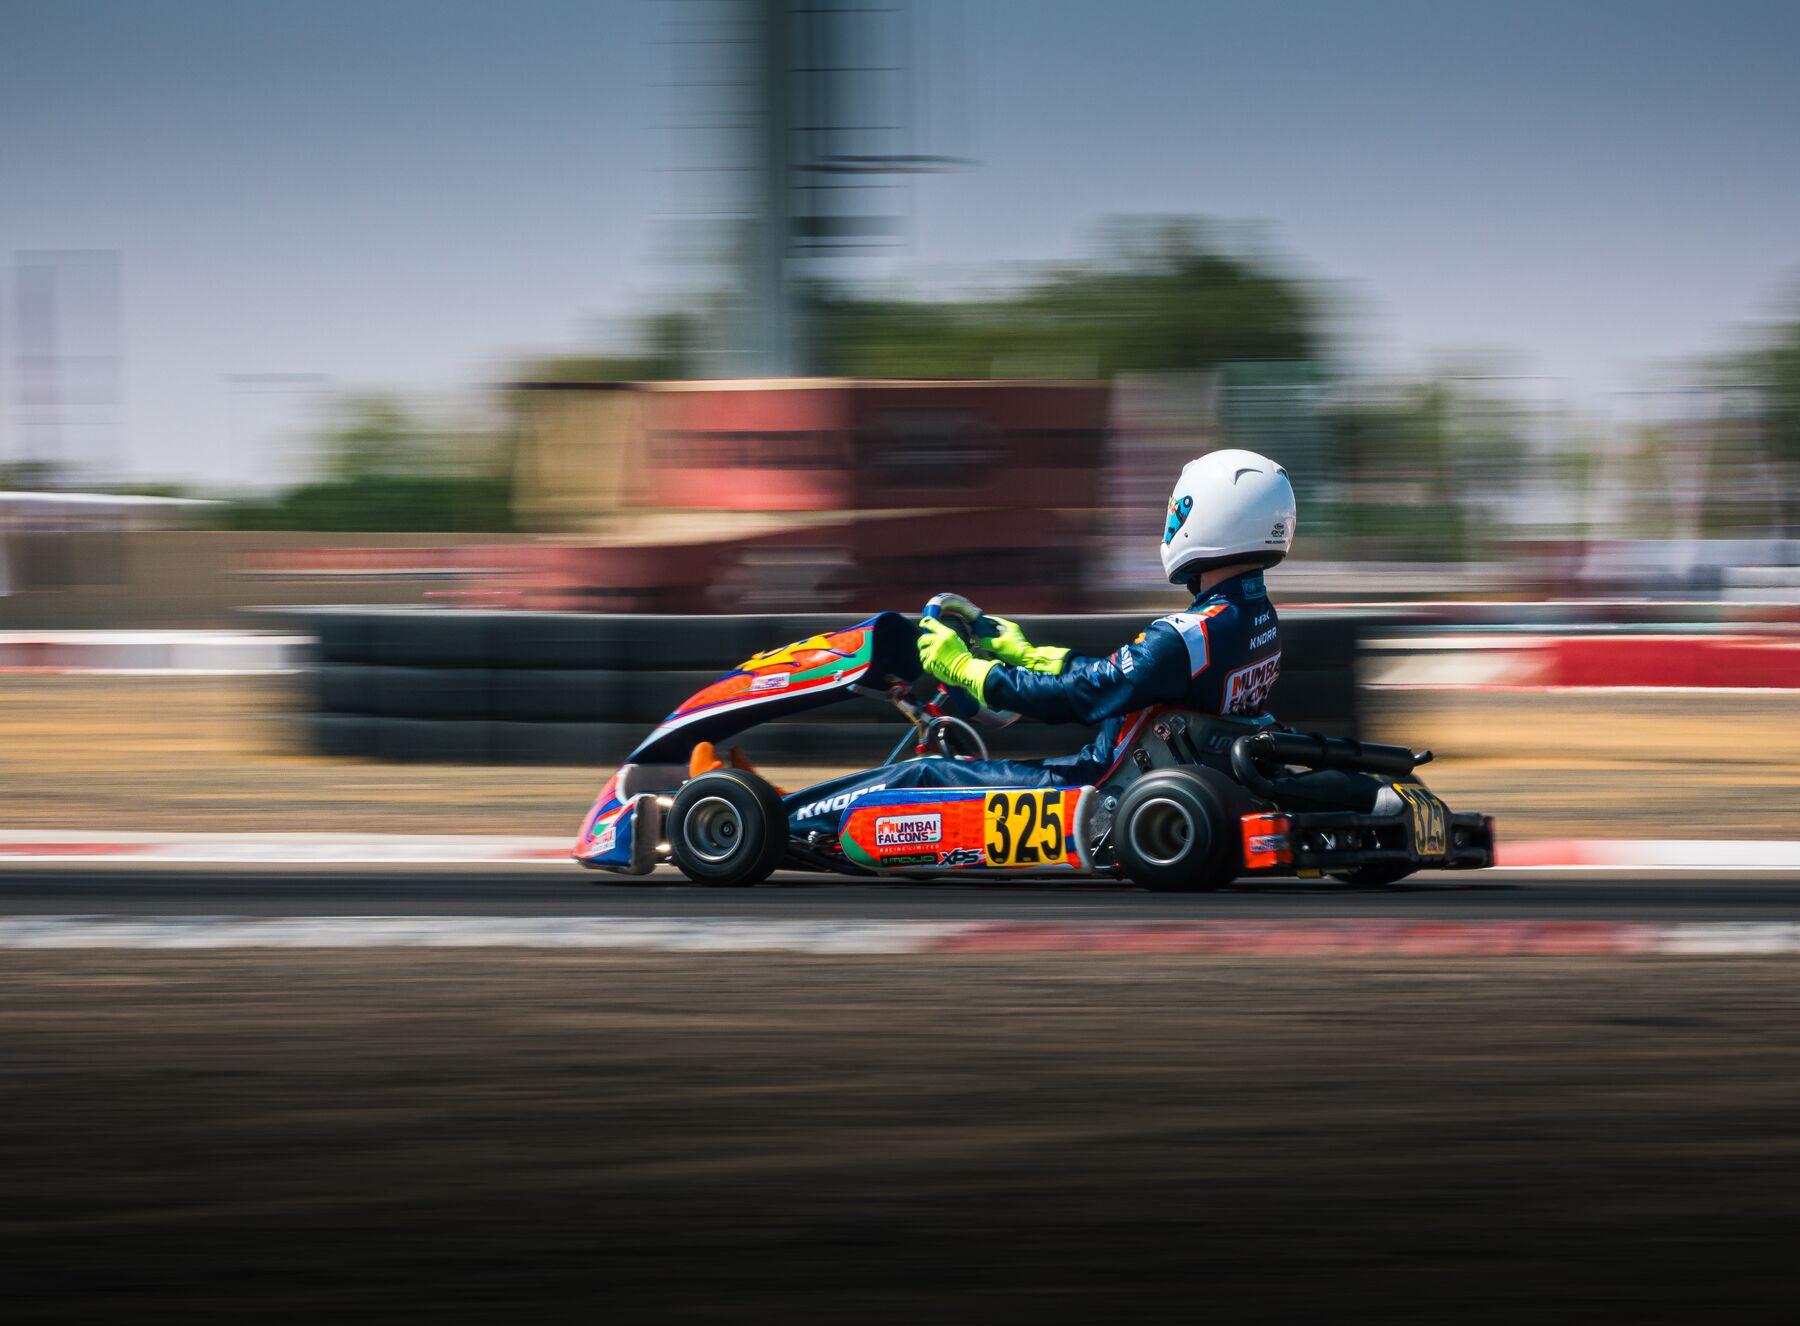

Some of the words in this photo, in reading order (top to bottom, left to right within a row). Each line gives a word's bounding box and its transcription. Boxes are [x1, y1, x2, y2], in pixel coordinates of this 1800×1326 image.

[1249, 626, 1277, 650] KNORR
[878, 820, 938, 834] MUMBAI
[987, 791, 1062, 864] 325
[878, 832, 929, 844] FALCONS
